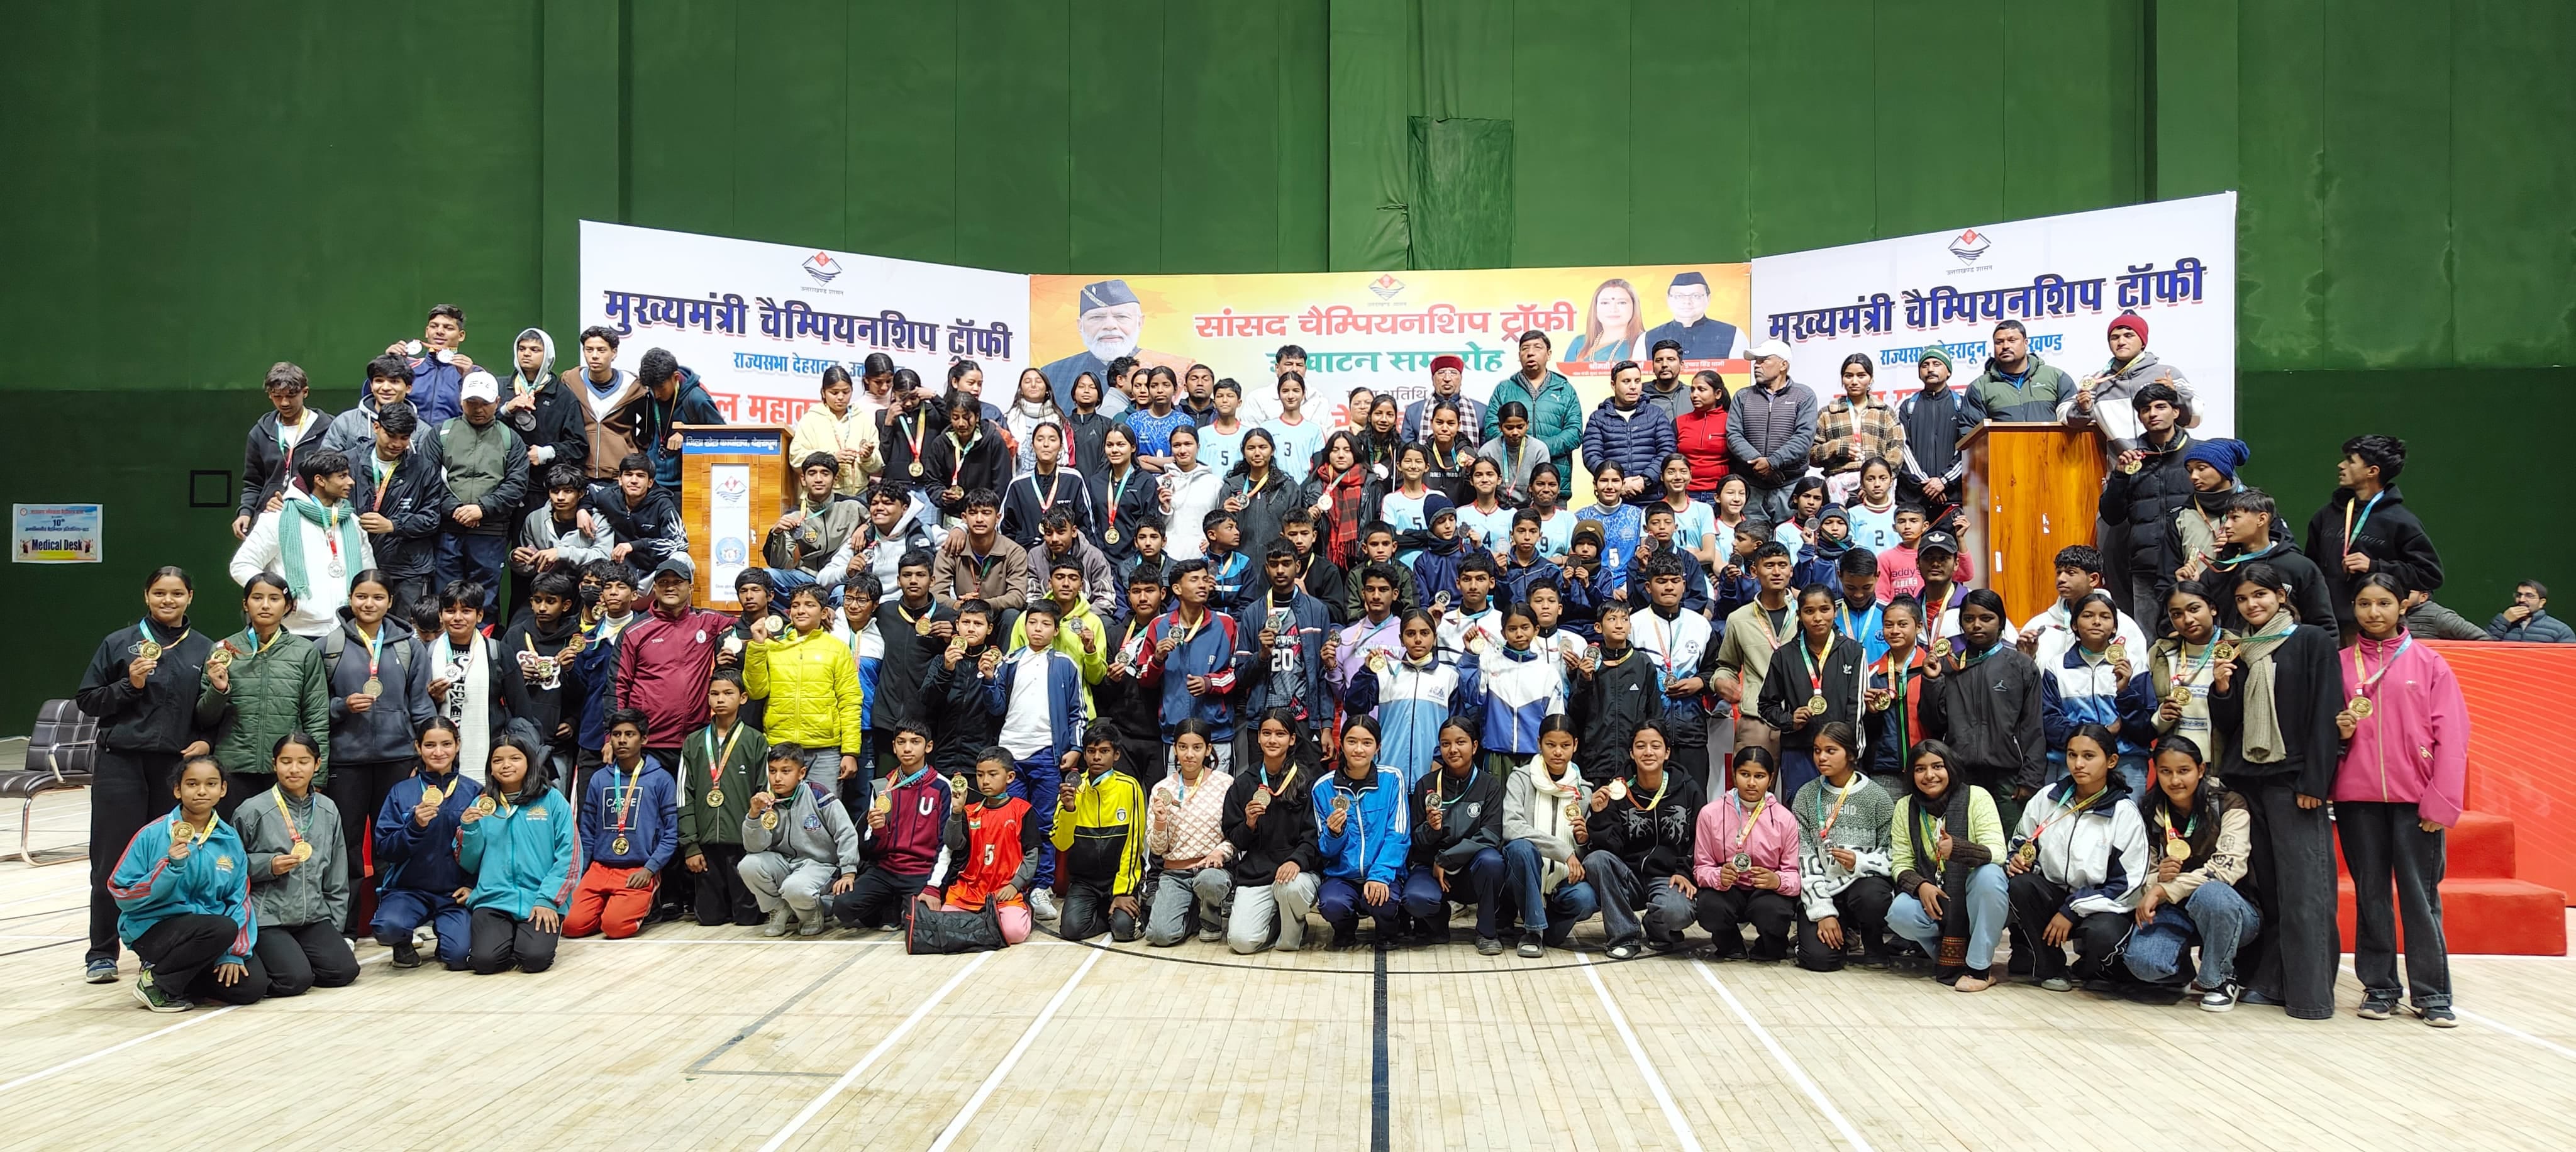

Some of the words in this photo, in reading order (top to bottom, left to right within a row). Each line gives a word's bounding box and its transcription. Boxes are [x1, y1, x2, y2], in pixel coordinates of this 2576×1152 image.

[1901, 274, 2106, 328] चैम्पियनशिप
[604, 289, 749, 335] मुख्यमंत्री
[755, 296, 940, 352] चैम्पियनशिप
[1194, 307, 1290, 337] सांसद
[1298, 304, 1492, 335] चैम्पियनशिप
[1500, 301, 1577, 342] ट्रॉफी
[733, 352, 788, 372] राज्यसभा
[1284, 441, 1292, 457] 3
[1221, 450, 1229, 466] 5
[1413, 516, 1423, 530] 5
[31, 539, 62, 550] Medical
[64, 539, 82, 550] Desk
[1482, 531, 1492, 548] 4
[1539, 536, 1548, 553] 9
[1875, 530, 1884, 546] 2
[1609, 548, 1620, 568] 5
[1891, 567, 1921, 577] addy's
[1271, 648, 1294, 672] 20
[606, 797, 637, 807] CARE
[919, 797, 934, 816] U
[984, 844, 995, 865] 5
